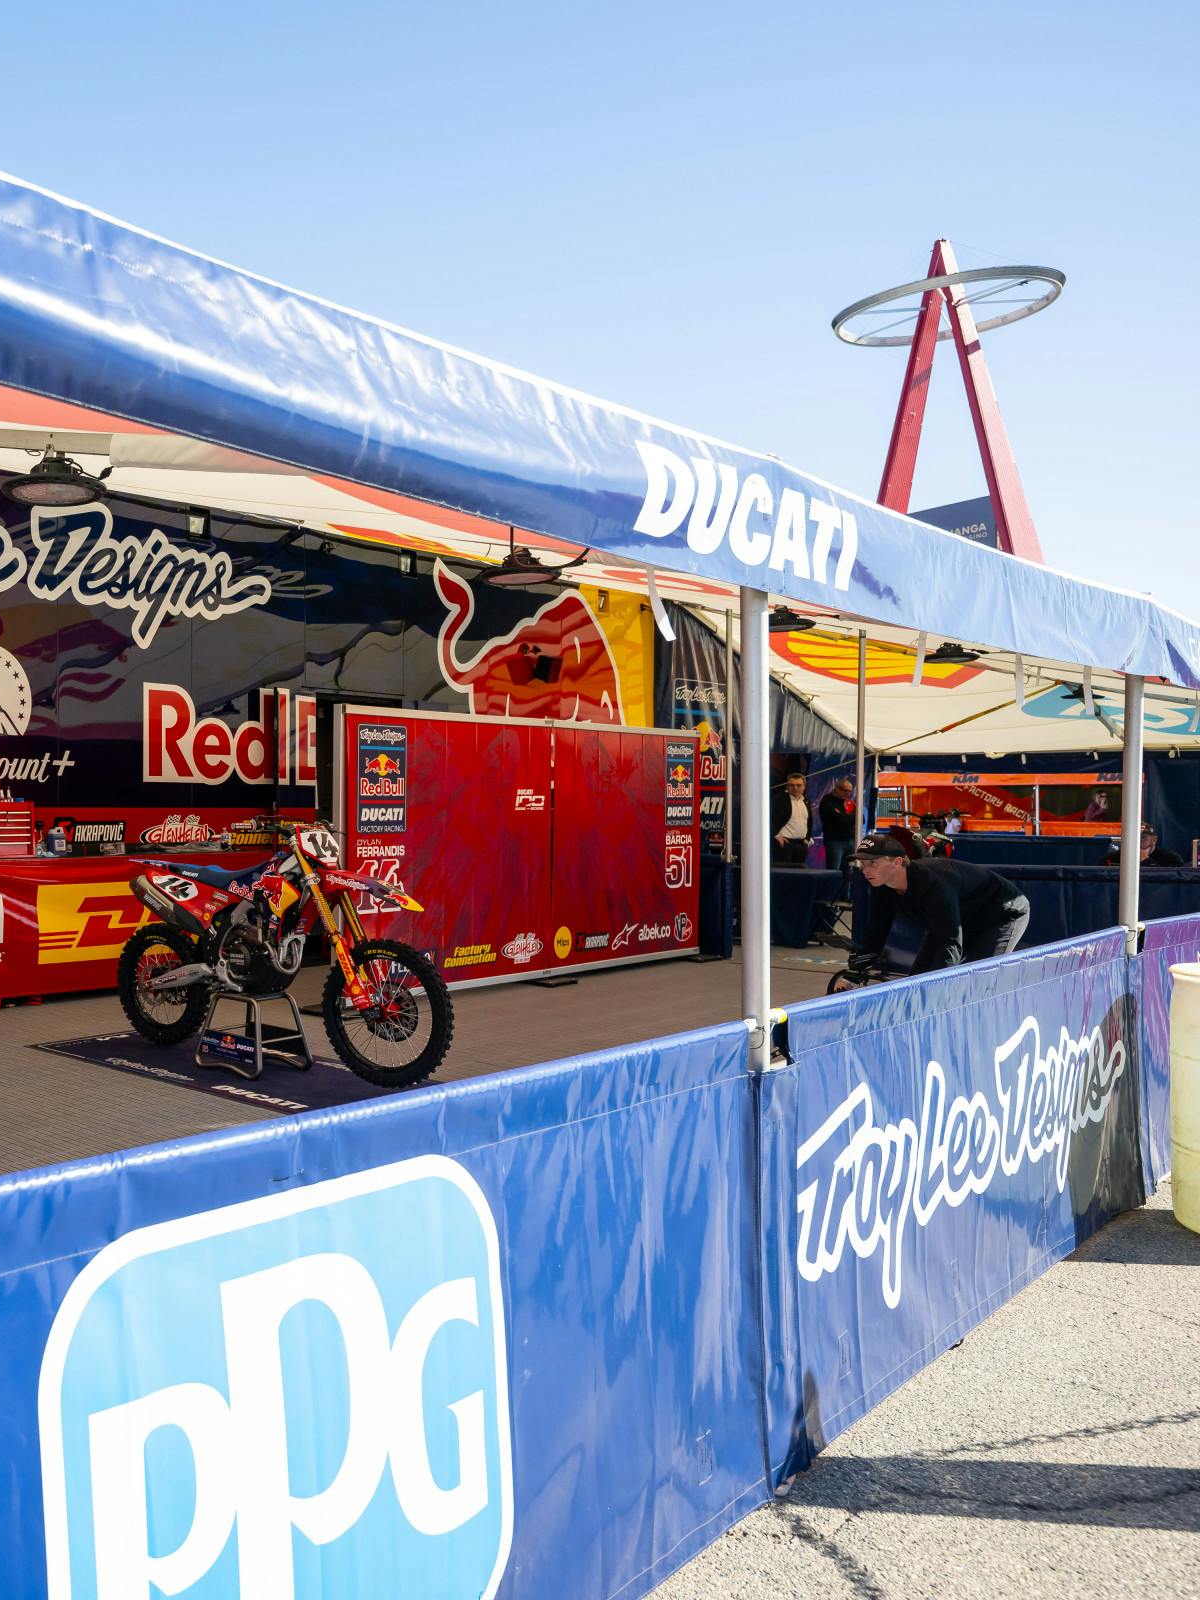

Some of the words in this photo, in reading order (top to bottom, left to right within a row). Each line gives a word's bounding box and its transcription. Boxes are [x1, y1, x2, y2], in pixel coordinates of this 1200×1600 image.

[633, 440, 858, 591] DUCATI
[950, 523, 987, 536] ANGA
[27, 502, 272, 649] Designs
[143, 682, 290, 785] Red
[700, 756, 726, 780] Bull
[360, 778, 383, 796] Red
[383, 778, 404, 796] Bull
[952, 775, 980, 783] KTM
[667, 783, 680, 797] Red
[680, 783, 693, 797] Bull
[667, 806, 692, 817] DUCATI
[700, 796, 724, 814] ATI
[963, 785, 1002, 808] FACTORY
[1004, 803, 1034, 823] RACIN
[361, 808, 404, 821] DUCATI
[74, 822, 124, 842] AKRAPOVIČ
[360, 825, 384, 833] FACTORY
[307, 833, 339, 858] 14
[666, 834, 692, 845] BARCIA
[356, 845, 405, 858] FERRANDIS
[665, 846, 692, 888] 51
[454, 943, 491, 957] Factory
[557, 938, 569, 948] Mips
[367, 949, 397, 958] DUNLOP
[211, 1085, 309, 1109] DUCATI
[797, 1082, 918, 1309] Troy
[913, 1060, 1000, 1226] Lee
[995, 1016, 1126, 1193] Designs
[88, 1252, 488, 1600] PPG
